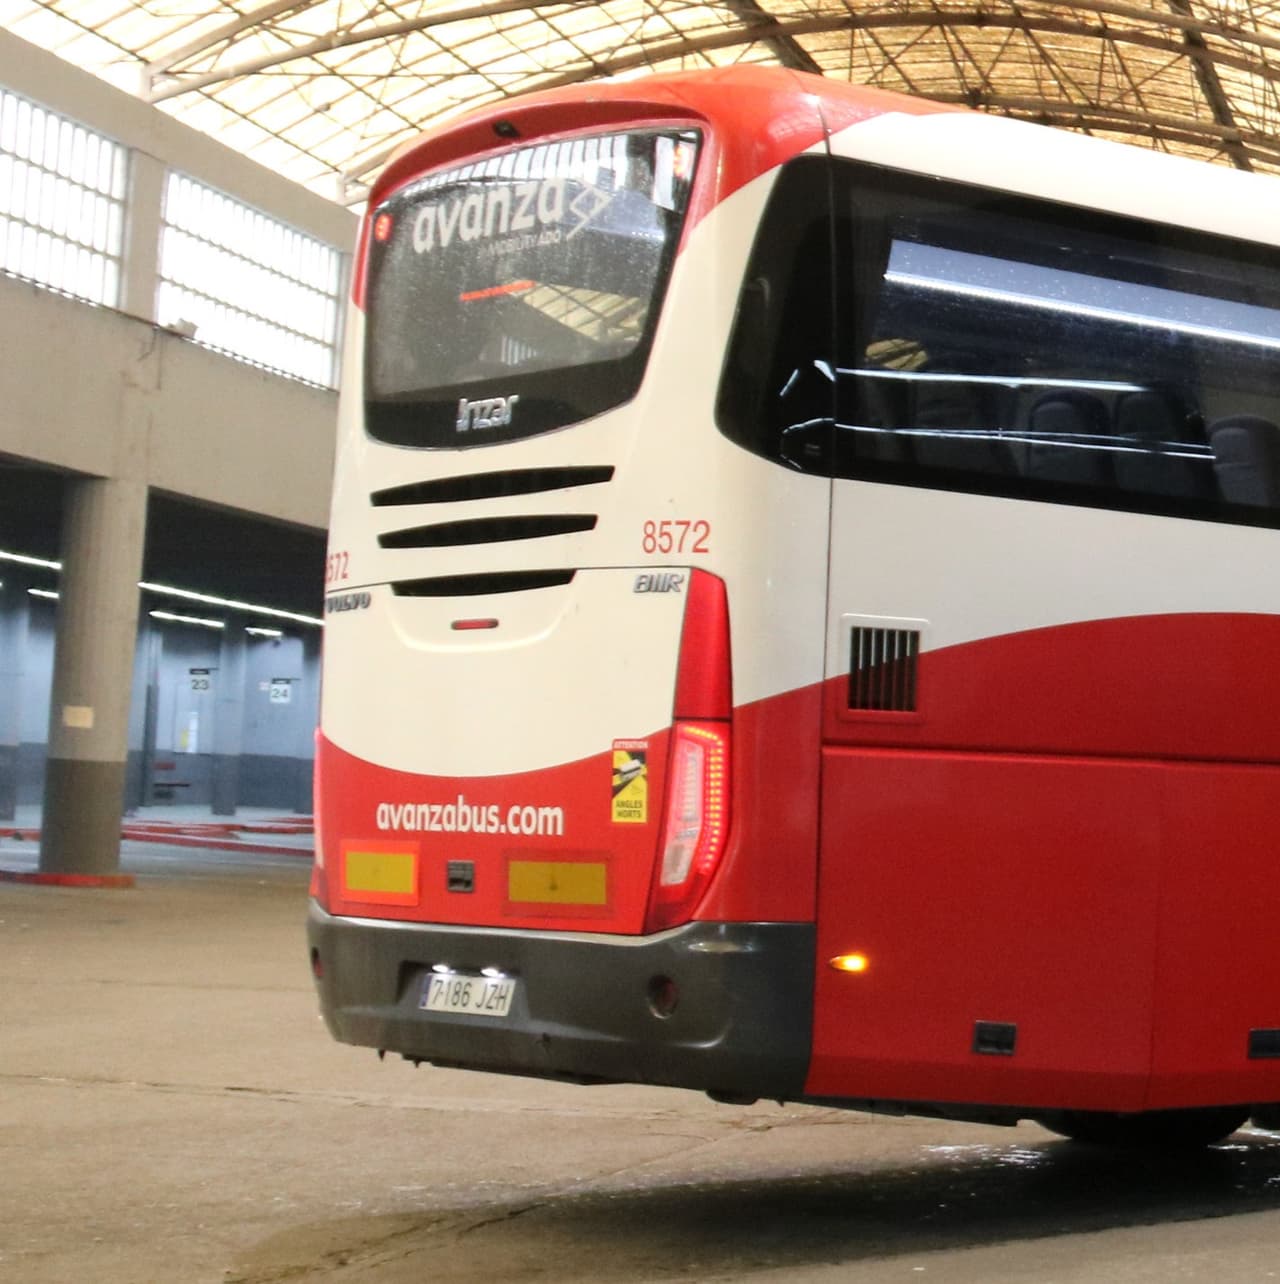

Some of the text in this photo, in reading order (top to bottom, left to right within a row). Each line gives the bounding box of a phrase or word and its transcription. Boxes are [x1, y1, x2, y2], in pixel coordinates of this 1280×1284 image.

[413, 177, 566, 254] avanza
[642, 519, 711, 554] 8572
[191, 679, 210, 690] 23
[271, 688, 289, 698] 24
[376, 794, 564, 836] avanzabus.com
[432, 980, 510, 1012] 7186 JZH
